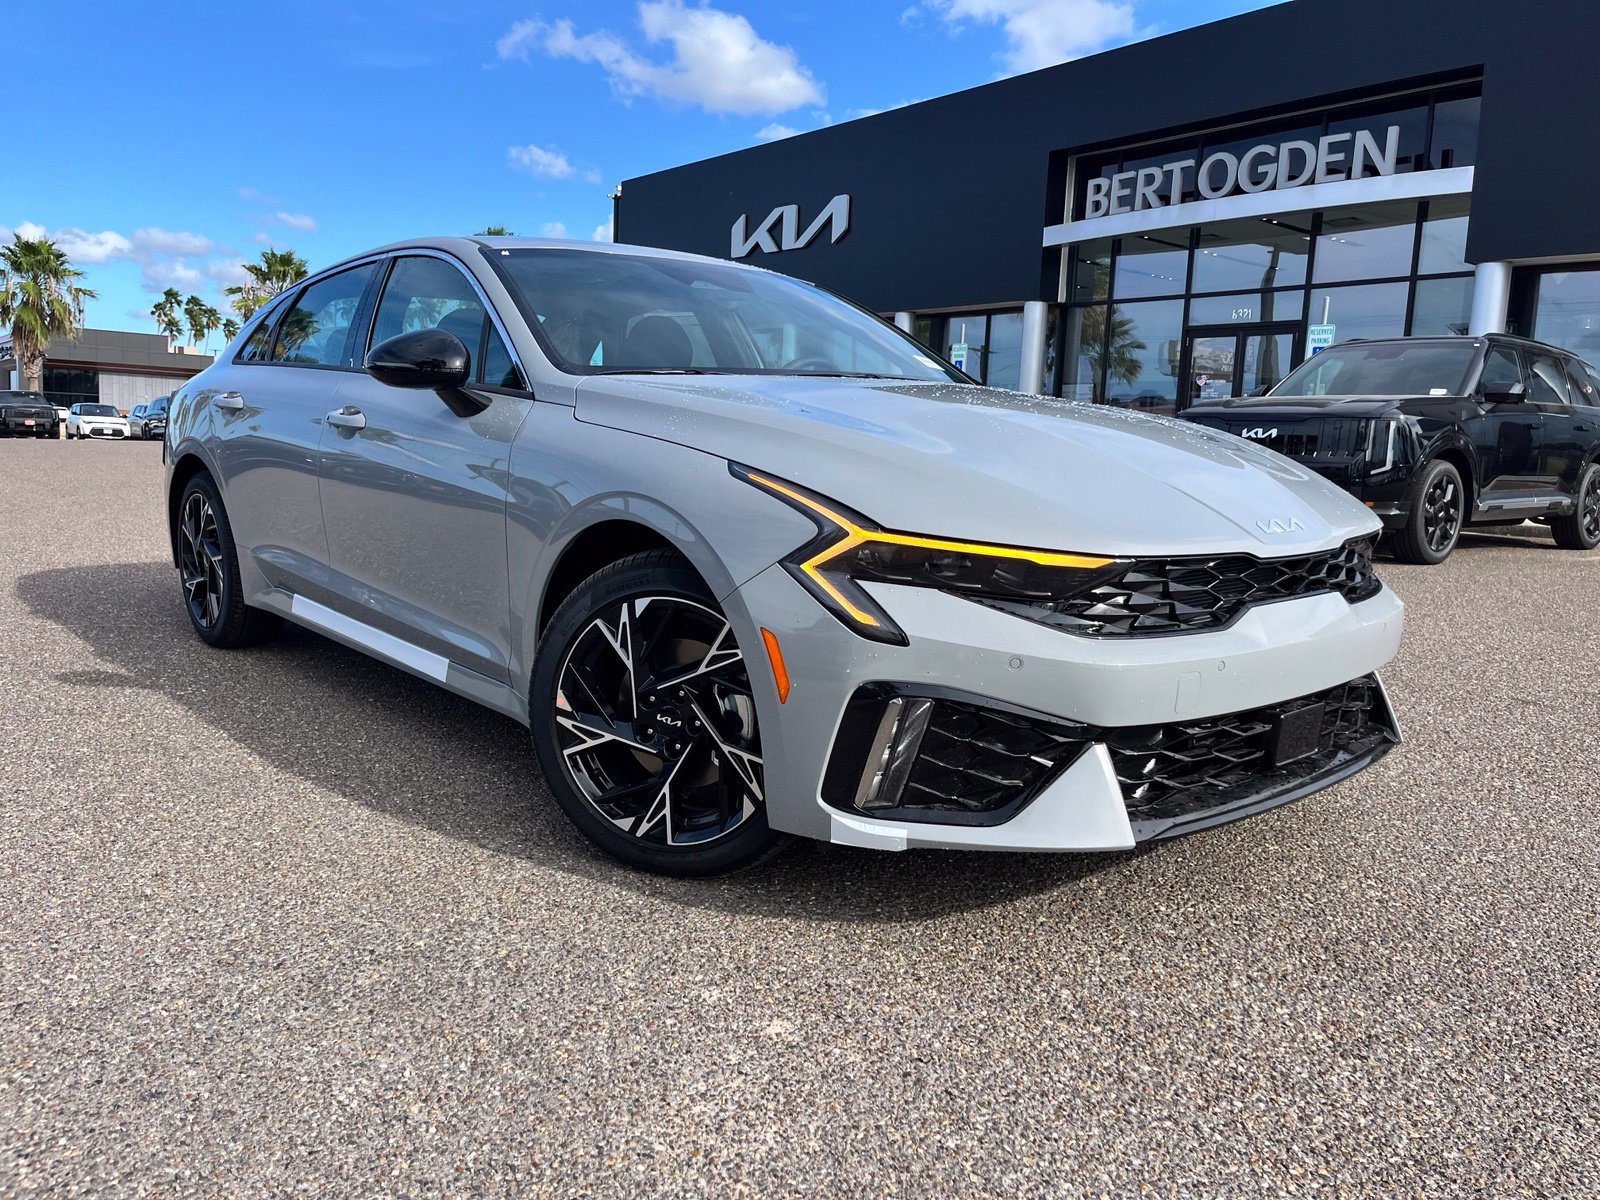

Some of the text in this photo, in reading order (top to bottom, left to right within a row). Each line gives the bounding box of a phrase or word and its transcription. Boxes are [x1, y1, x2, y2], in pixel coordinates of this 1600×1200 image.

[1085, 125, 1400, 220] BERT OGDEN
[731, 193, 850, 259] KIA
[1310, 328, 1334, 336] RESERVED
[1241, 427, 1278, 439] KIA
[1255, 516, 1304, 535] KIA
[656, 713, 682, 728] KIA
